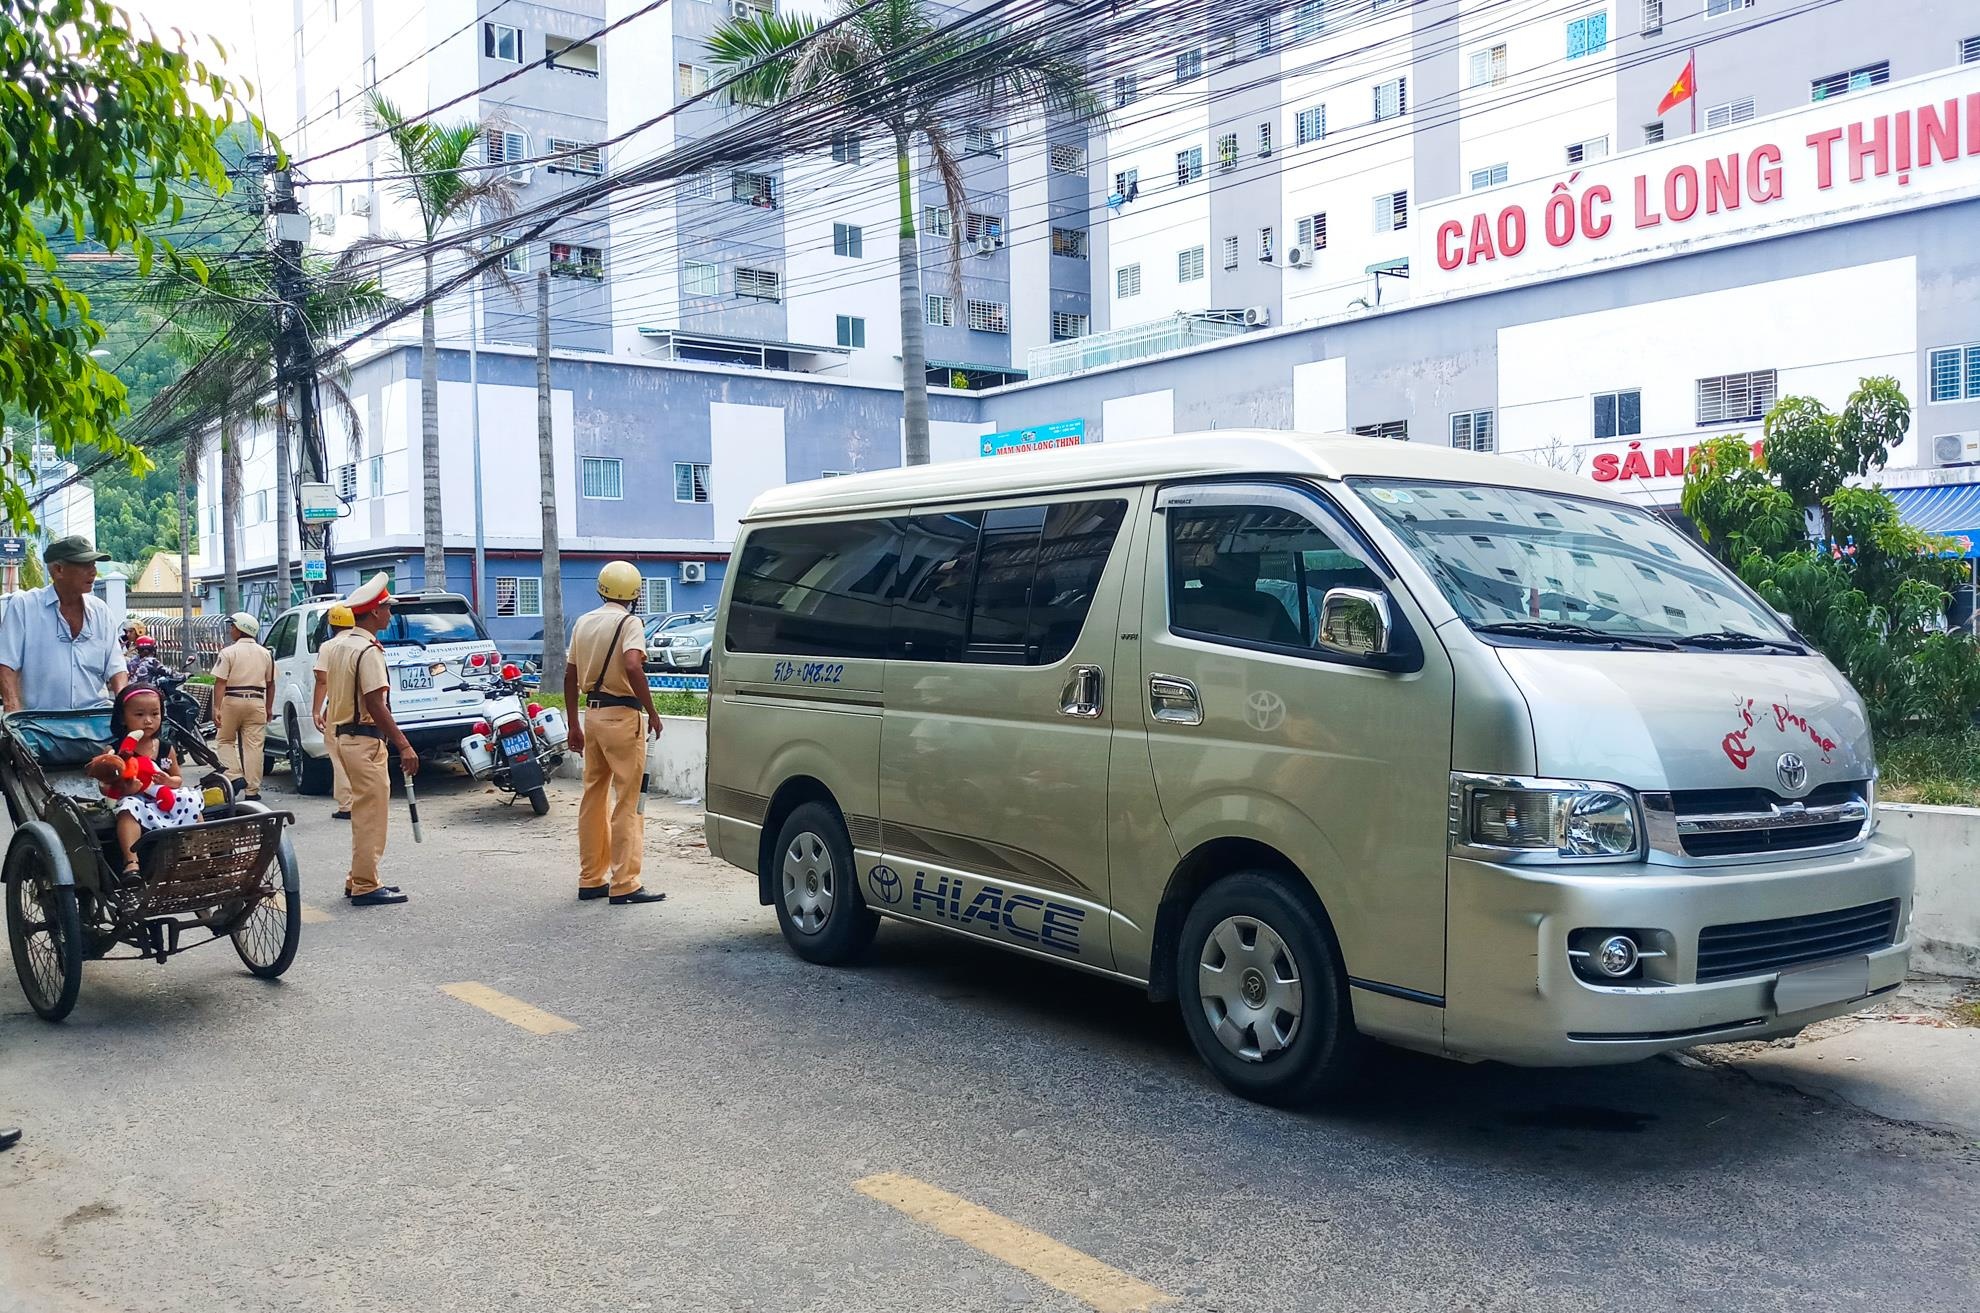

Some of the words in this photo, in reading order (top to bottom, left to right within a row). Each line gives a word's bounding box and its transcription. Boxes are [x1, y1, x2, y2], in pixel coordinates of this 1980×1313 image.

[1436, 204, 1528, 271] CAO
[1545, 171, 1613, 247] ỐC
[1634, 143, 1785, 230] LONG
[1015, 444, 1032, 454] NON
[1033, 440, 1054, 451] LONG
[407, 667, 425, 678] 77A
[913, 871, 1085, 954] HIACE
